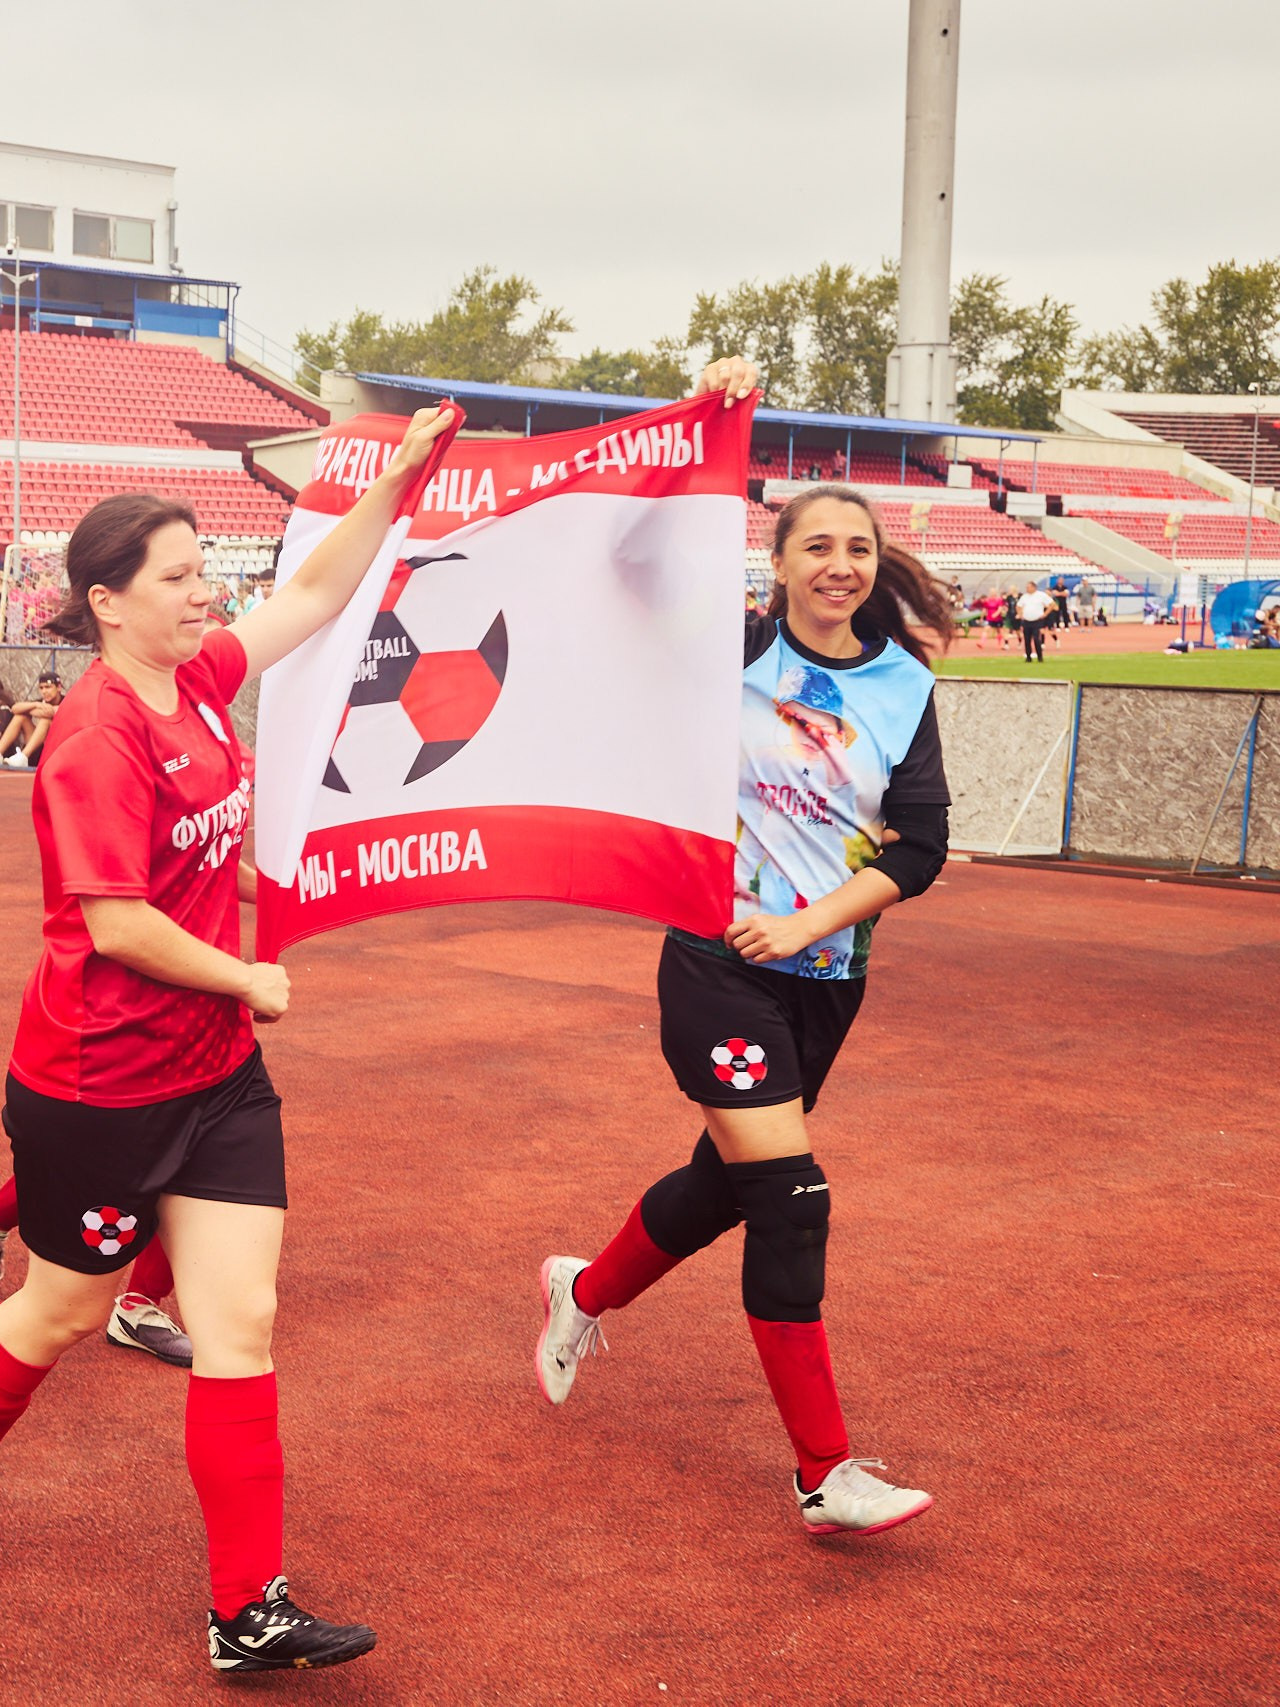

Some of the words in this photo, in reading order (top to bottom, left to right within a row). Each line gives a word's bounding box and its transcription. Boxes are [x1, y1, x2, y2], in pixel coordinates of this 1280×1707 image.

[422, 468, 497, 521] НЦА
[361, 635, 412, 661] TBALL
[353, 660, 379, 683] OM!
[299, 850, 337, 905] МЫ
[357, 828, 488, 888] МОСКВА
